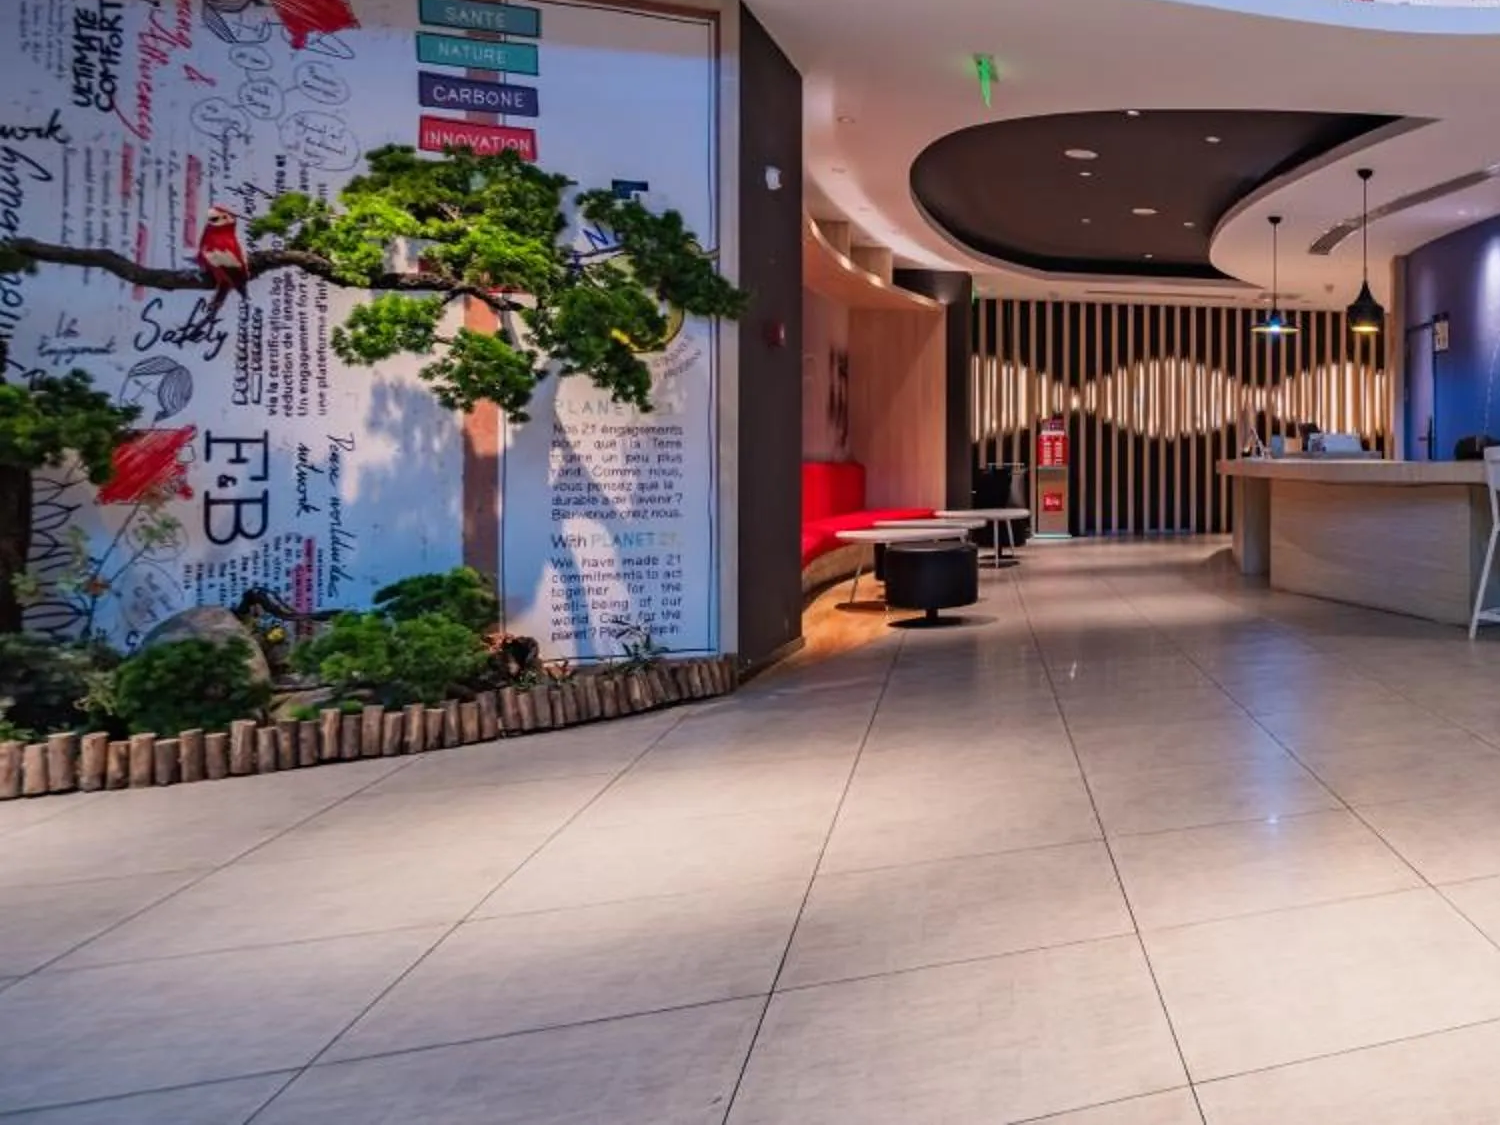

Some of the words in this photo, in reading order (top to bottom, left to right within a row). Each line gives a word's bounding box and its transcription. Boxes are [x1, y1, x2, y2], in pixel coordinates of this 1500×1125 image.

[438, 41, 507, 65] NATURE
[432, 85, 525, 109] CARBONE
[424, 129, 532, 154] INNOVATION
[295, 283, 308, 307] fort
[133, 296, 230, 362] Safety
[266, 299, 281, 378] certification
[281, 333, 293, 349] de
[298, 311, 311, 394] engagement
[315, 315, 328, 389] plateforme
[266, 382, 278, 393] la
[282, 353, 293, 417] réduction
[267, 396, 278, 416] via
[552, 424, 577, 436] Nos
[581, 424, 597, 436] 21
[600, 425, 683, 438] engagements
[552, 439, 582, 451] pour
[593, 438, 617, 451] que
[629, 438, 641, 449] la
[654, 438, 683, 449] Terre
[602, 453, 618, 463] un
[626, 452, 650, 465] peu
[658, 452, 683, 465] plus
[592, 466, 641, 478] Comme
[203, 428, 270, 546] F&B
[552, 482, 583, 492] vous
[587, 481, 633, 493] pensez
[638, 481, 659, 493] que
[552, 495, 599, 506] durable
[552, 509, 616, 521] Bienvenue
[620, 508, 649, 520] chez
[552, 533, 587, 549] With
[590, 533, 655, 548] PLANET
[552, 556, 574, 569] We
[582, 556, 615, 568] have
[622, 555, 659, 567] made
[666, 554, 681, 566] 21
[552, 570, 642, 585] commitments
[647, 569, 659, 580] to
[664, 569, 682, 580] act
[552, 585, 609, 599] together
[627, 584, 645, 594] for
[661, 583, 681, 593] the
[639, 597, 653, 608] of
[661, 597, 682, 607] our
[599, 612, 632, 624] Care
[638, 610, 657, 625] for
[661, 610, 681, 621] the
